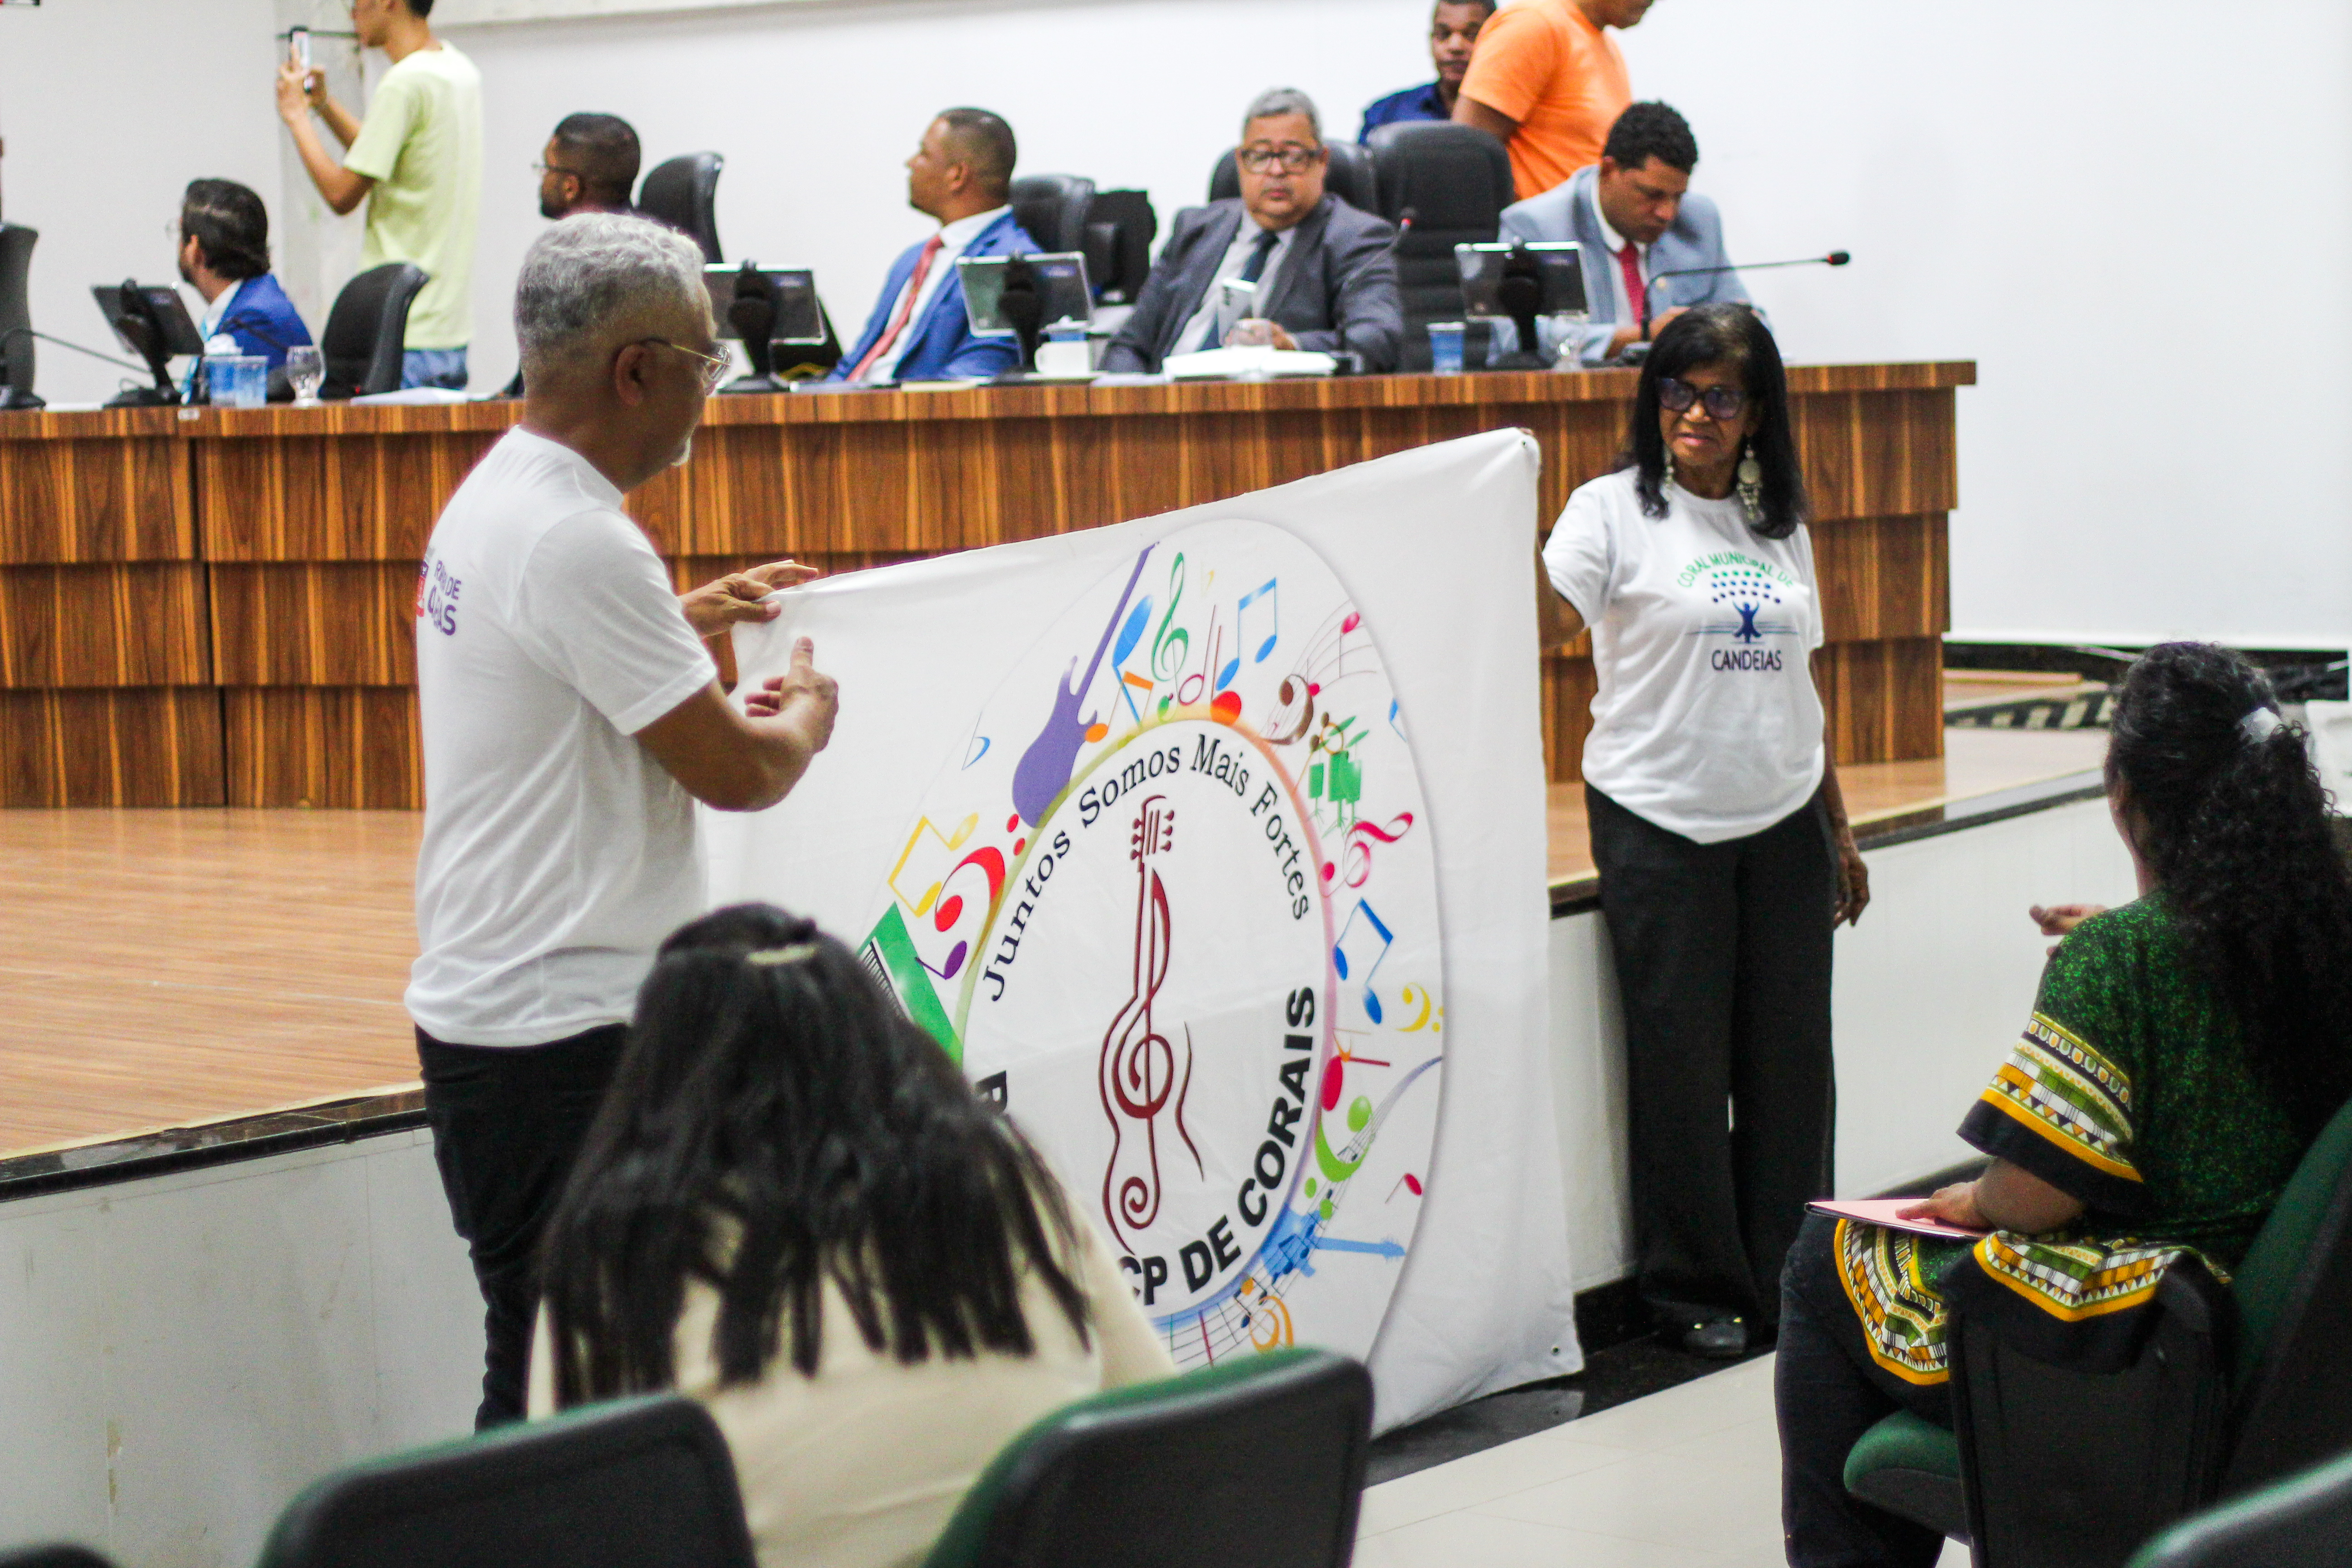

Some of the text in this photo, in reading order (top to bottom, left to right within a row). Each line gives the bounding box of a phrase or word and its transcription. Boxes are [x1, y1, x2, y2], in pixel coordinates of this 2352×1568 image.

[1677, 551, 1793, 588] CORAL MUNICIPAL DE
[1711, 649, 1782, 671] CANDEIAS
[982, 734, 1308, 1001] Juntos Somos Mais Fortes
[1178, 1215, 1242, 1293] DE
[1238, 986, 1315, 1227] CORAIS
